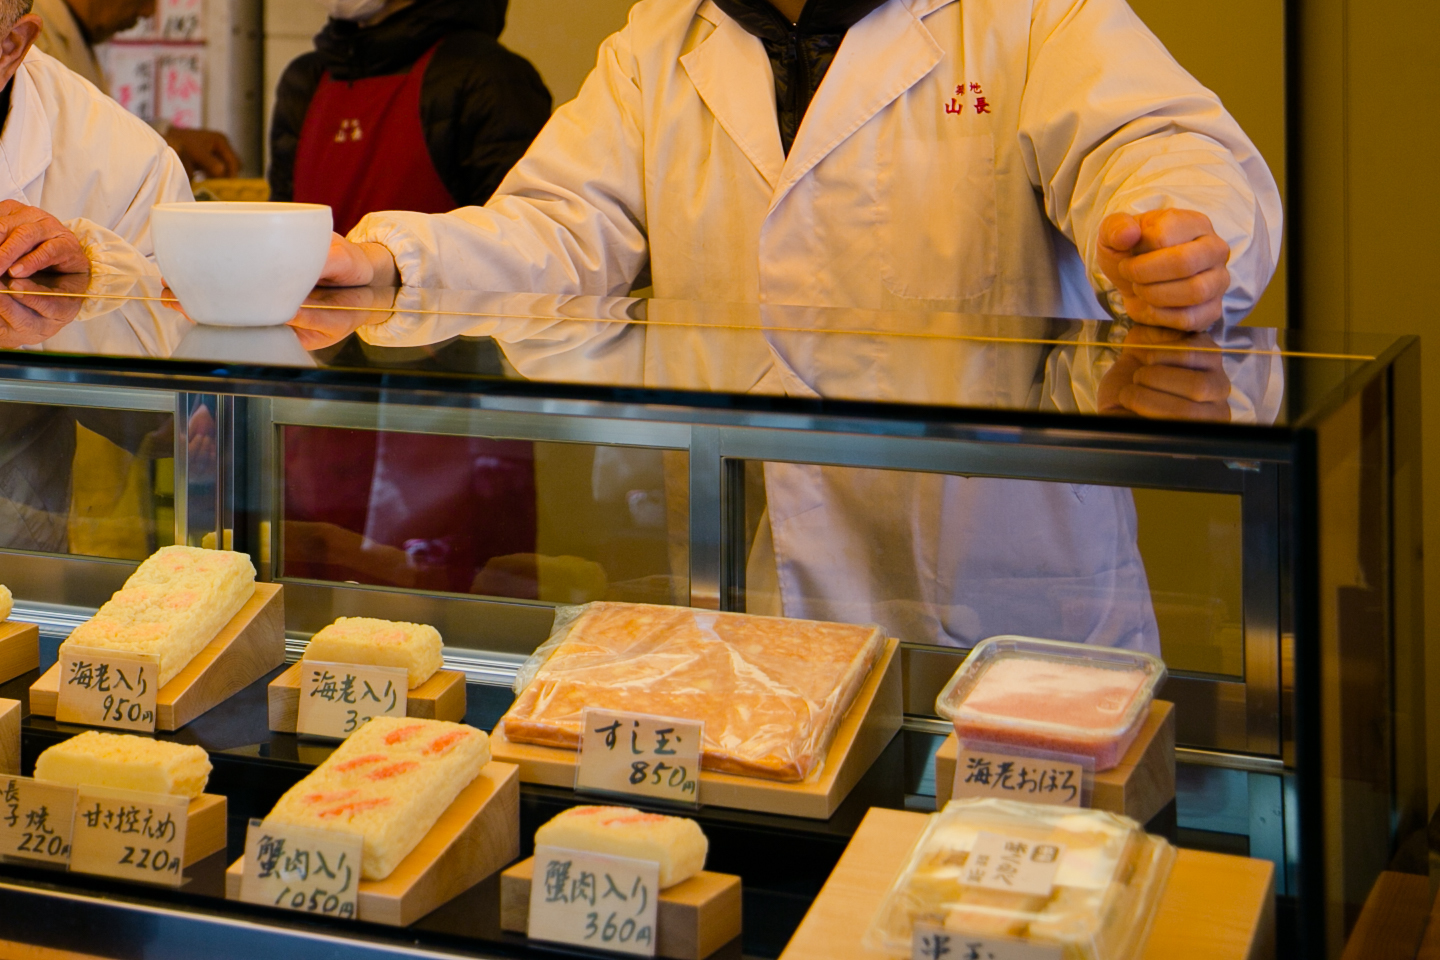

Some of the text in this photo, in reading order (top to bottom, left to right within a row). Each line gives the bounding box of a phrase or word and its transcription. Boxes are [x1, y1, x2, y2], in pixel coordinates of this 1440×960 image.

[944, 96, 991, 116] 山長
[68, 661, 148, 698] 海老入り
[311, 670, 398, 712] 海老入り
[102, 694, 154, 724] 950円
[594, 720, 682, 755] すし玉
[628, 760, 696, 795] 850円
[964, 757, 1078, 803] 海老おぼろ
[82, 803, 176, 843] 甘さ控えめ
[118, 846, 180, 875] 220円
[274, 886, 355, 919] 1050円
[544, 859, 648, 915] 蟹肉入り
[583, 912, 651, 945] 360円
